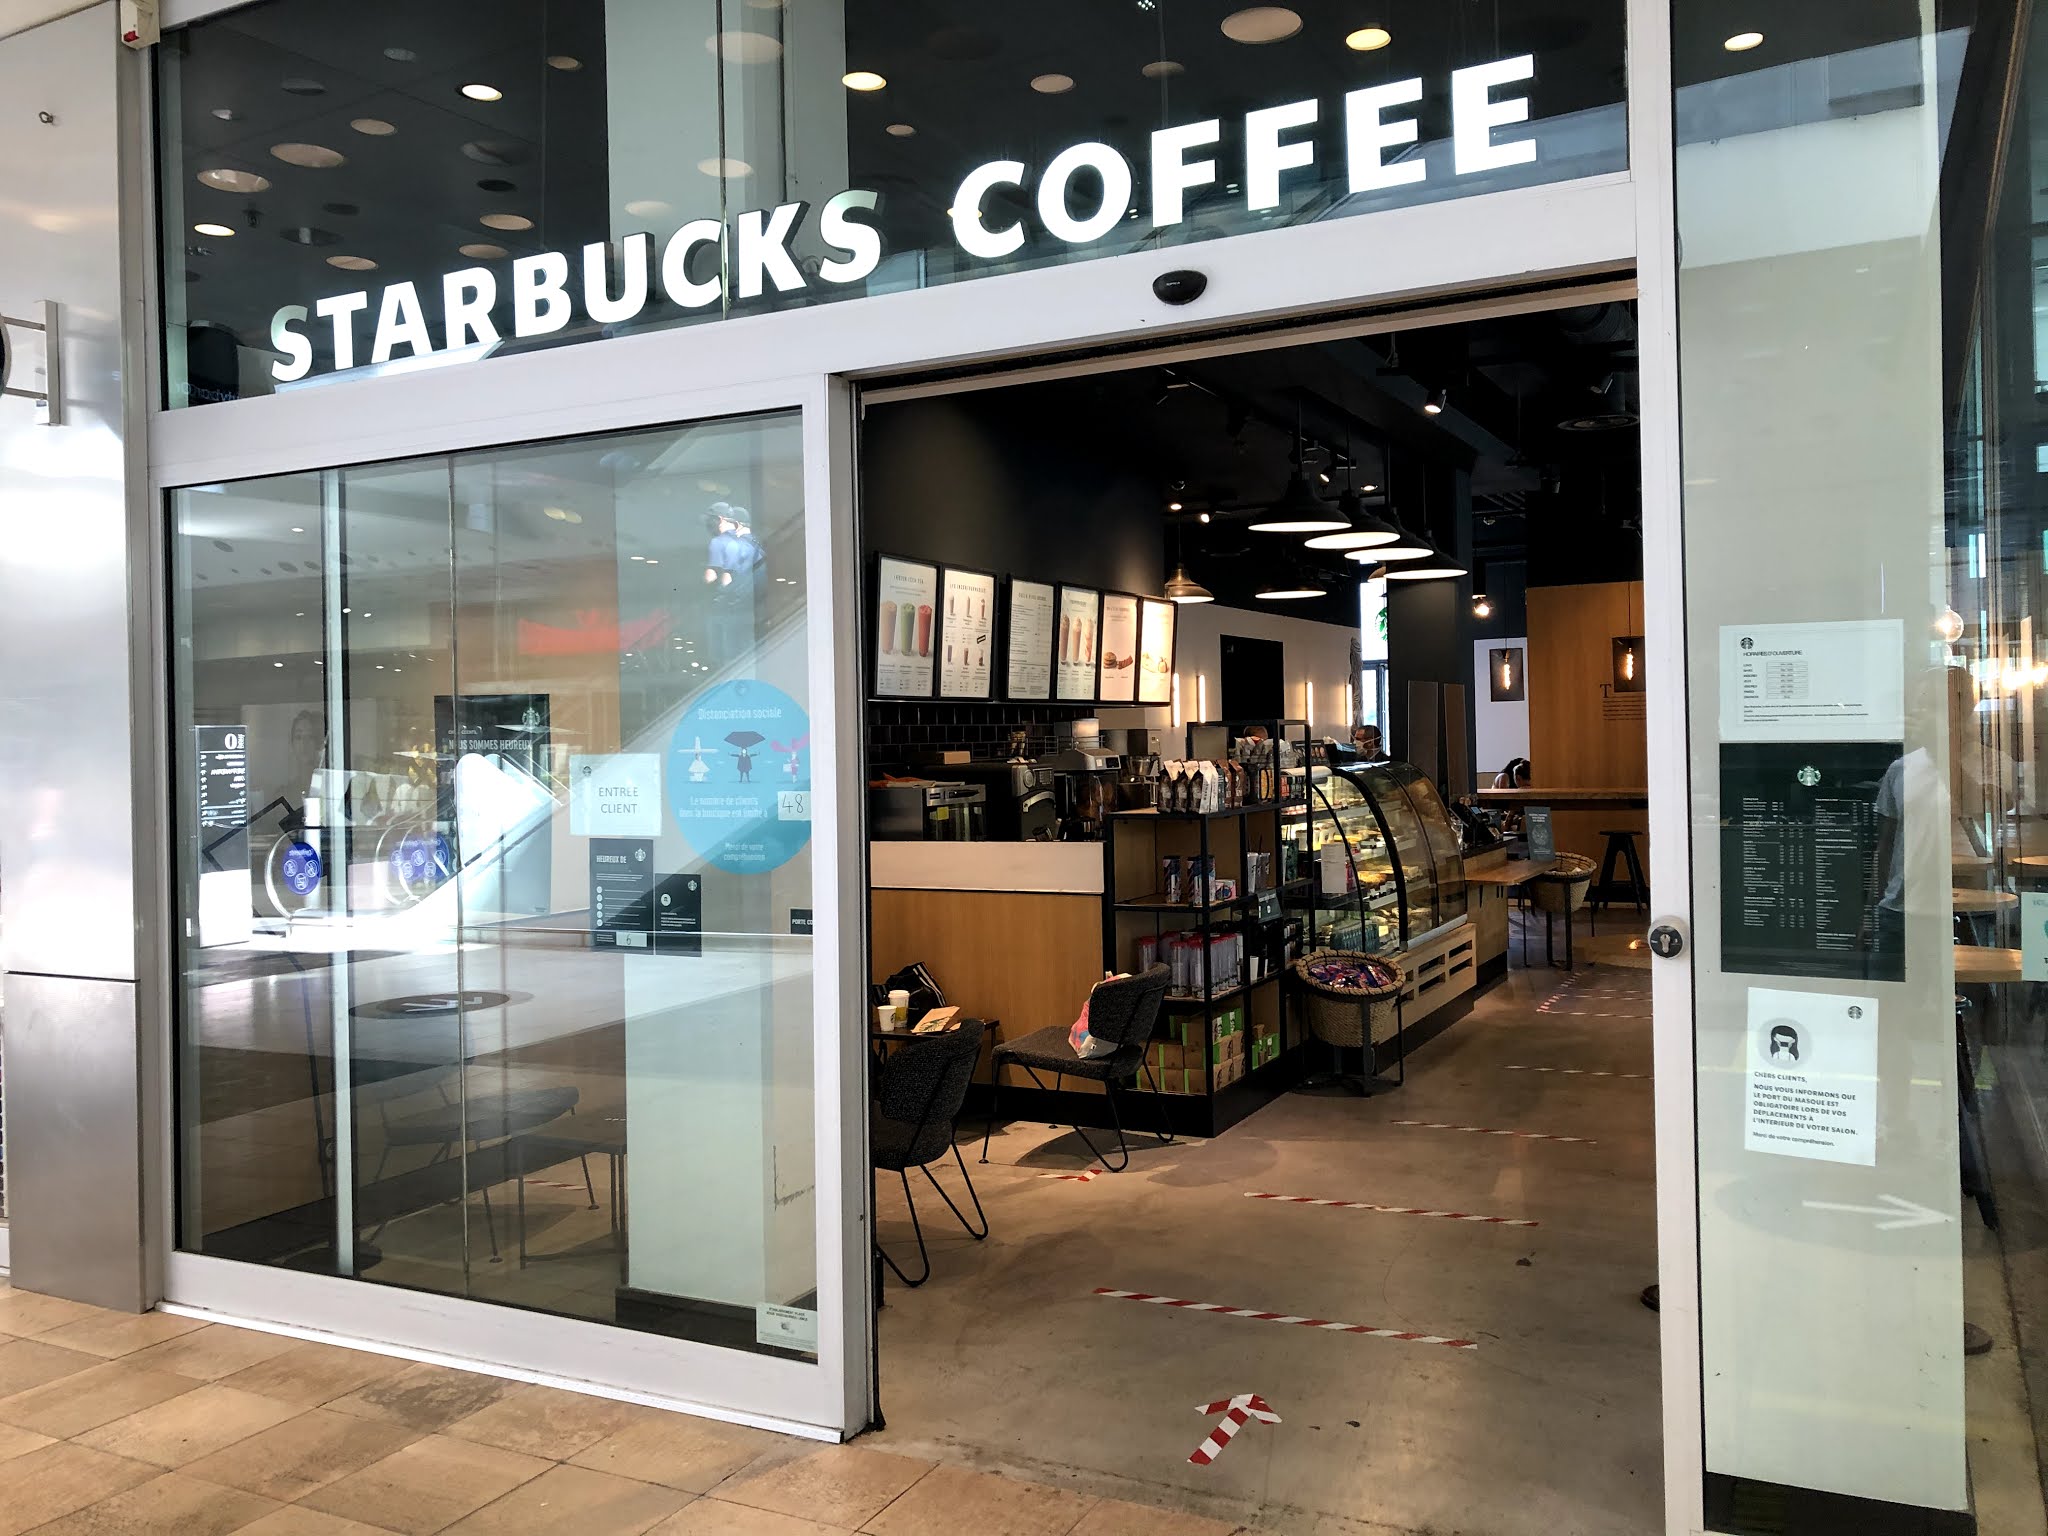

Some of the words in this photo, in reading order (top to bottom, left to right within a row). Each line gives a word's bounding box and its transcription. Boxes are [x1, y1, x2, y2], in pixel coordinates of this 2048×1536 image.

[270, 189, 882, 383] STARBUCKS
[948, 54, 1537, 258] COFFEE
[752, 706, 782, 719] sociale
[449, 740, 467, 750] NUS
[469, 740, 498, 750] SOMMES
[600, 803, 638, 814] CLIENT
[782, 793, 804, 814] 48
[596, 855, 619, 863] HEUREUX
[620, 856, 627, 864] DE
[1754, 1083, 1773, 1091] NOUS
[1774, 1086, 1794, 1094] VOUS
[1795, 1089, 1840, 1099] INFORMONS
[1841, 1093, 1856, 1101] QUE
[1753, 1100, 1799, 1111] OBLIGATOIRE
[1801, 1106, 1819, 1114] LORS
[1795, 1097, 1825, 1106] MASQUE
[1806, 1124, 1830, 1132] VOTRE
[1831, 1127, 1858, 1136] SALON.
